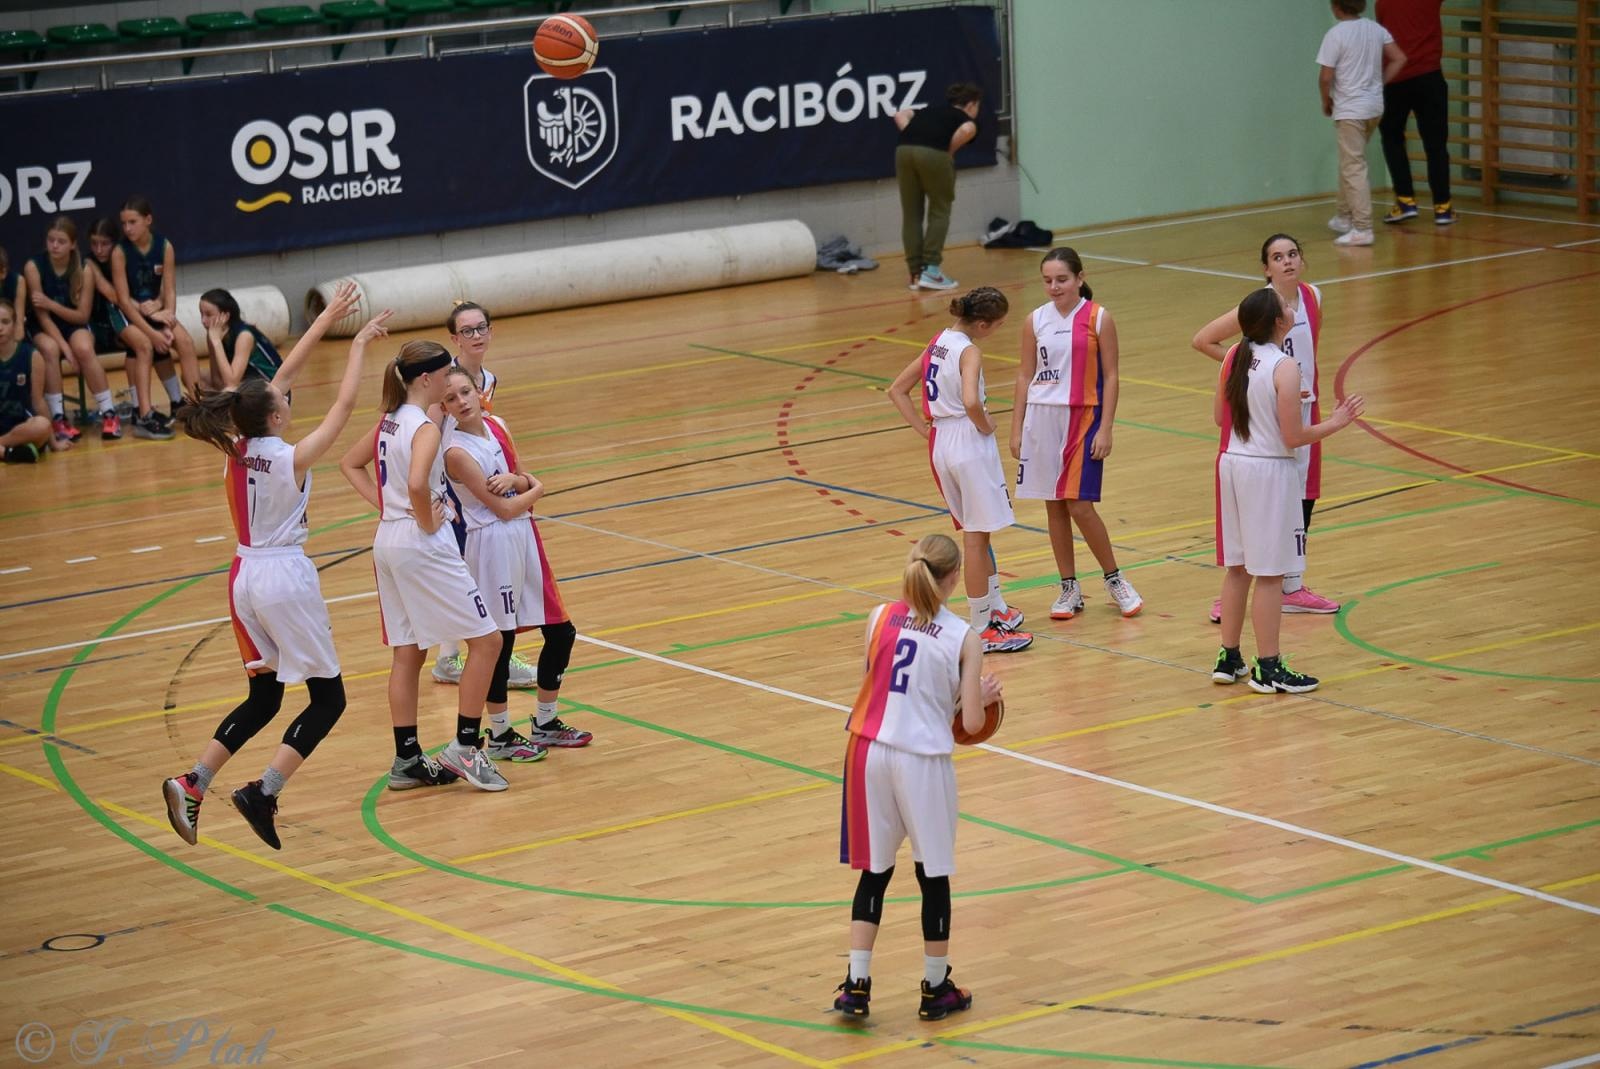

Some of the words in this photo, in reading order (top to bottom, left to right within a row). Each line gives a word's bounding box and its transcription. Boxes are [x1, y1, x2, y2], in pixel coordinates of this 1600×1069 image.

[670, 62, 928, 141] RACIBÓRZ
[302, 174, 402, 204] RACIBÓRZ
[1040, 346, 1048, 366] 9
[927, 363, 939, 401] 5
[474, 595, 487, 618] 6
[890, 638, 917, 694] 2
